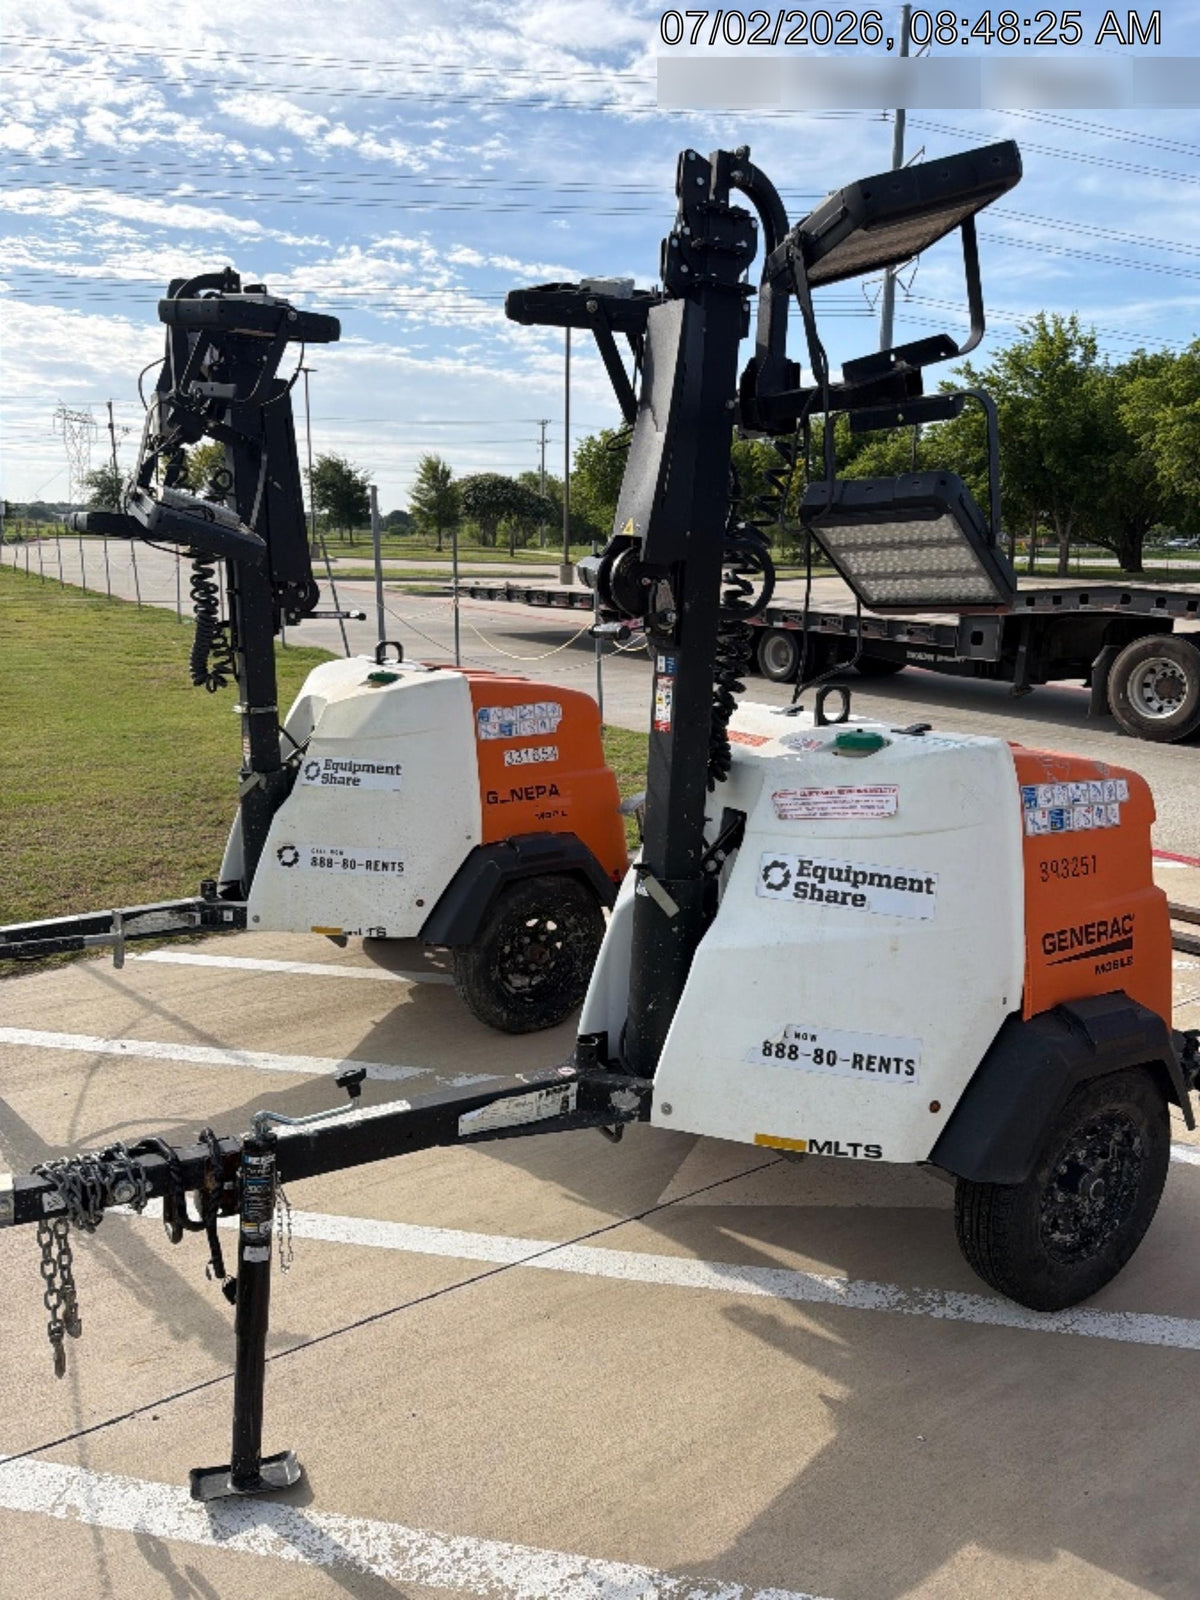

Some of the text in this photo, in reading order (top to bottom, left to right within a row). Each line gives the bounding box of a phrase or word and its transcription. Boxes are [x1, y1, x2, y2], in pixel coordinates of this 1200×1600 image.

[321, 773, 361, 787] Share
[323, 759, 402, 776] Equipment
[310, 856, 405, 873] 888-80-RENTS
[796, 858, 936, 895] Equipment
[1039, 855, 1097, 882] 393251
[792, 881, 867, 908] Share
[1042, 914, 1135, 955] GENERAC
[761, 1040, 916, 1077] 888-80-RENTS
[808, 1139, 883, 1159] MLTS
